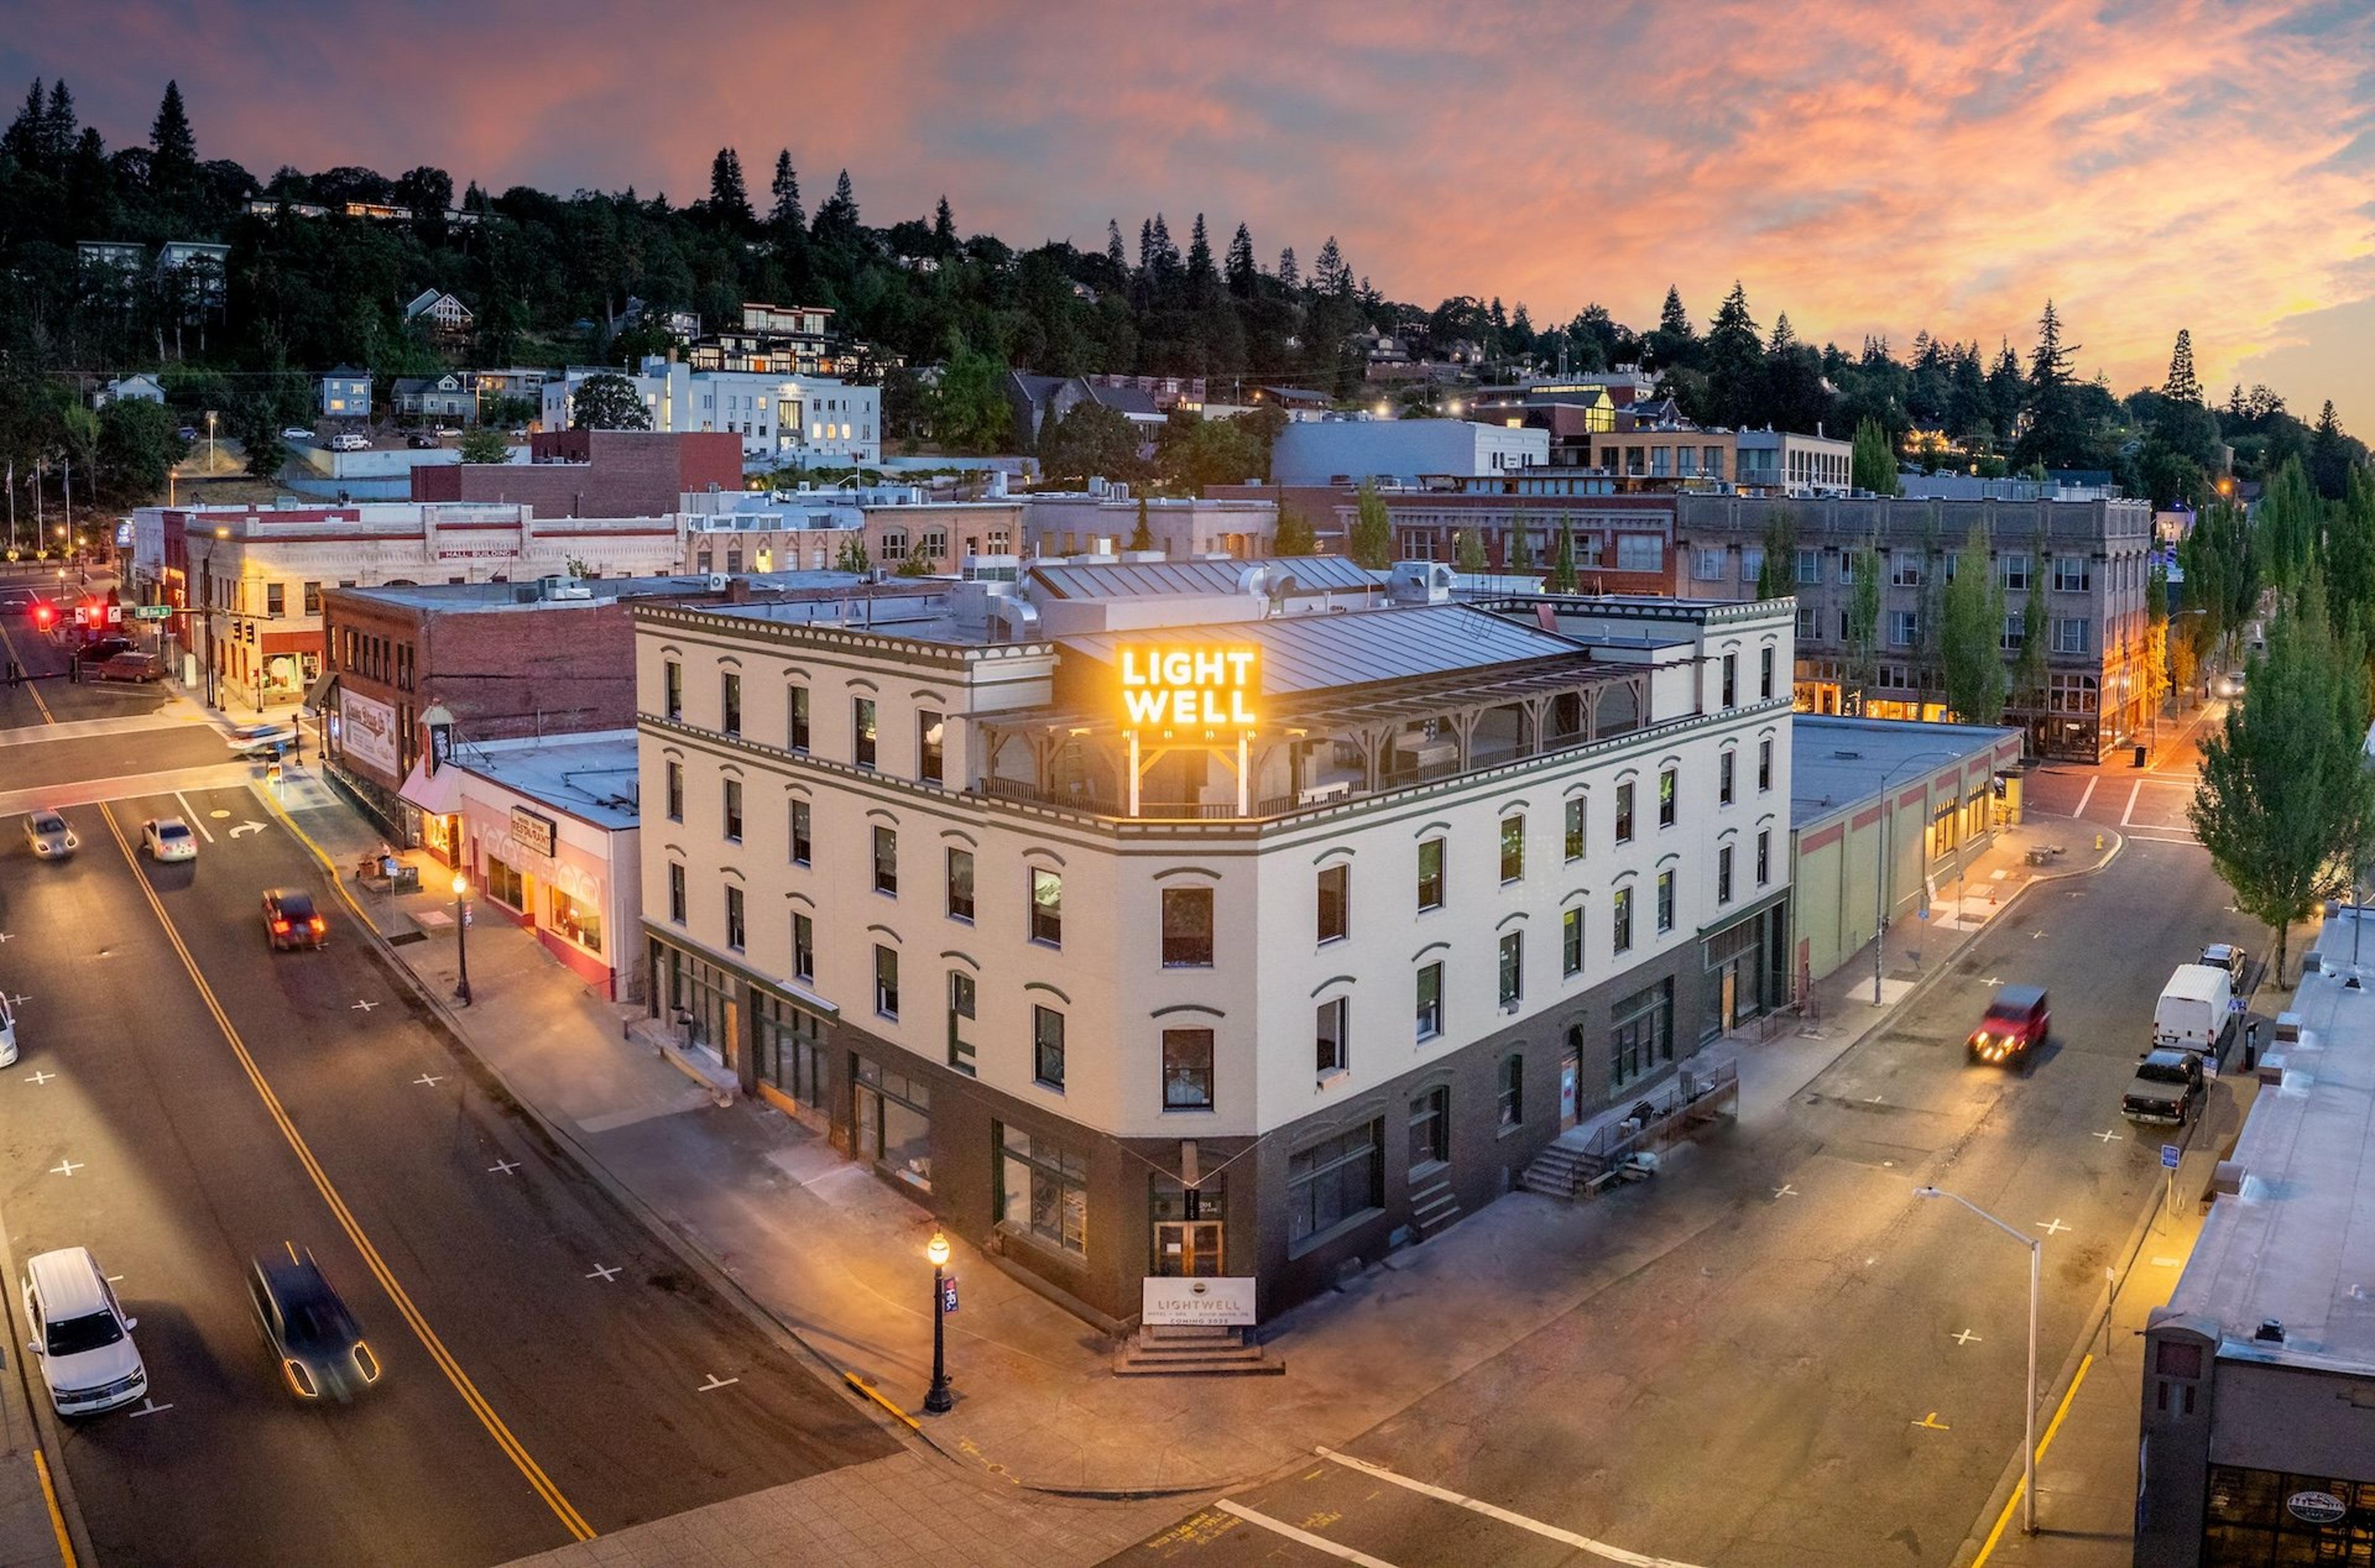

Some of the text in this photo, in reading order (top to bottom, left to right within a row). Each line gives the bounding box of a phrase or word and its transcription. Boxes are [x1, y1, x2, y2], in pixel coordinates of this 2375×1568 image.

[1123, 652, 1254, 684] LIGHT
[1123, 691, 1256, 723] WELL
[1158, 1300, 1240, 1310] LIGHTWELL
